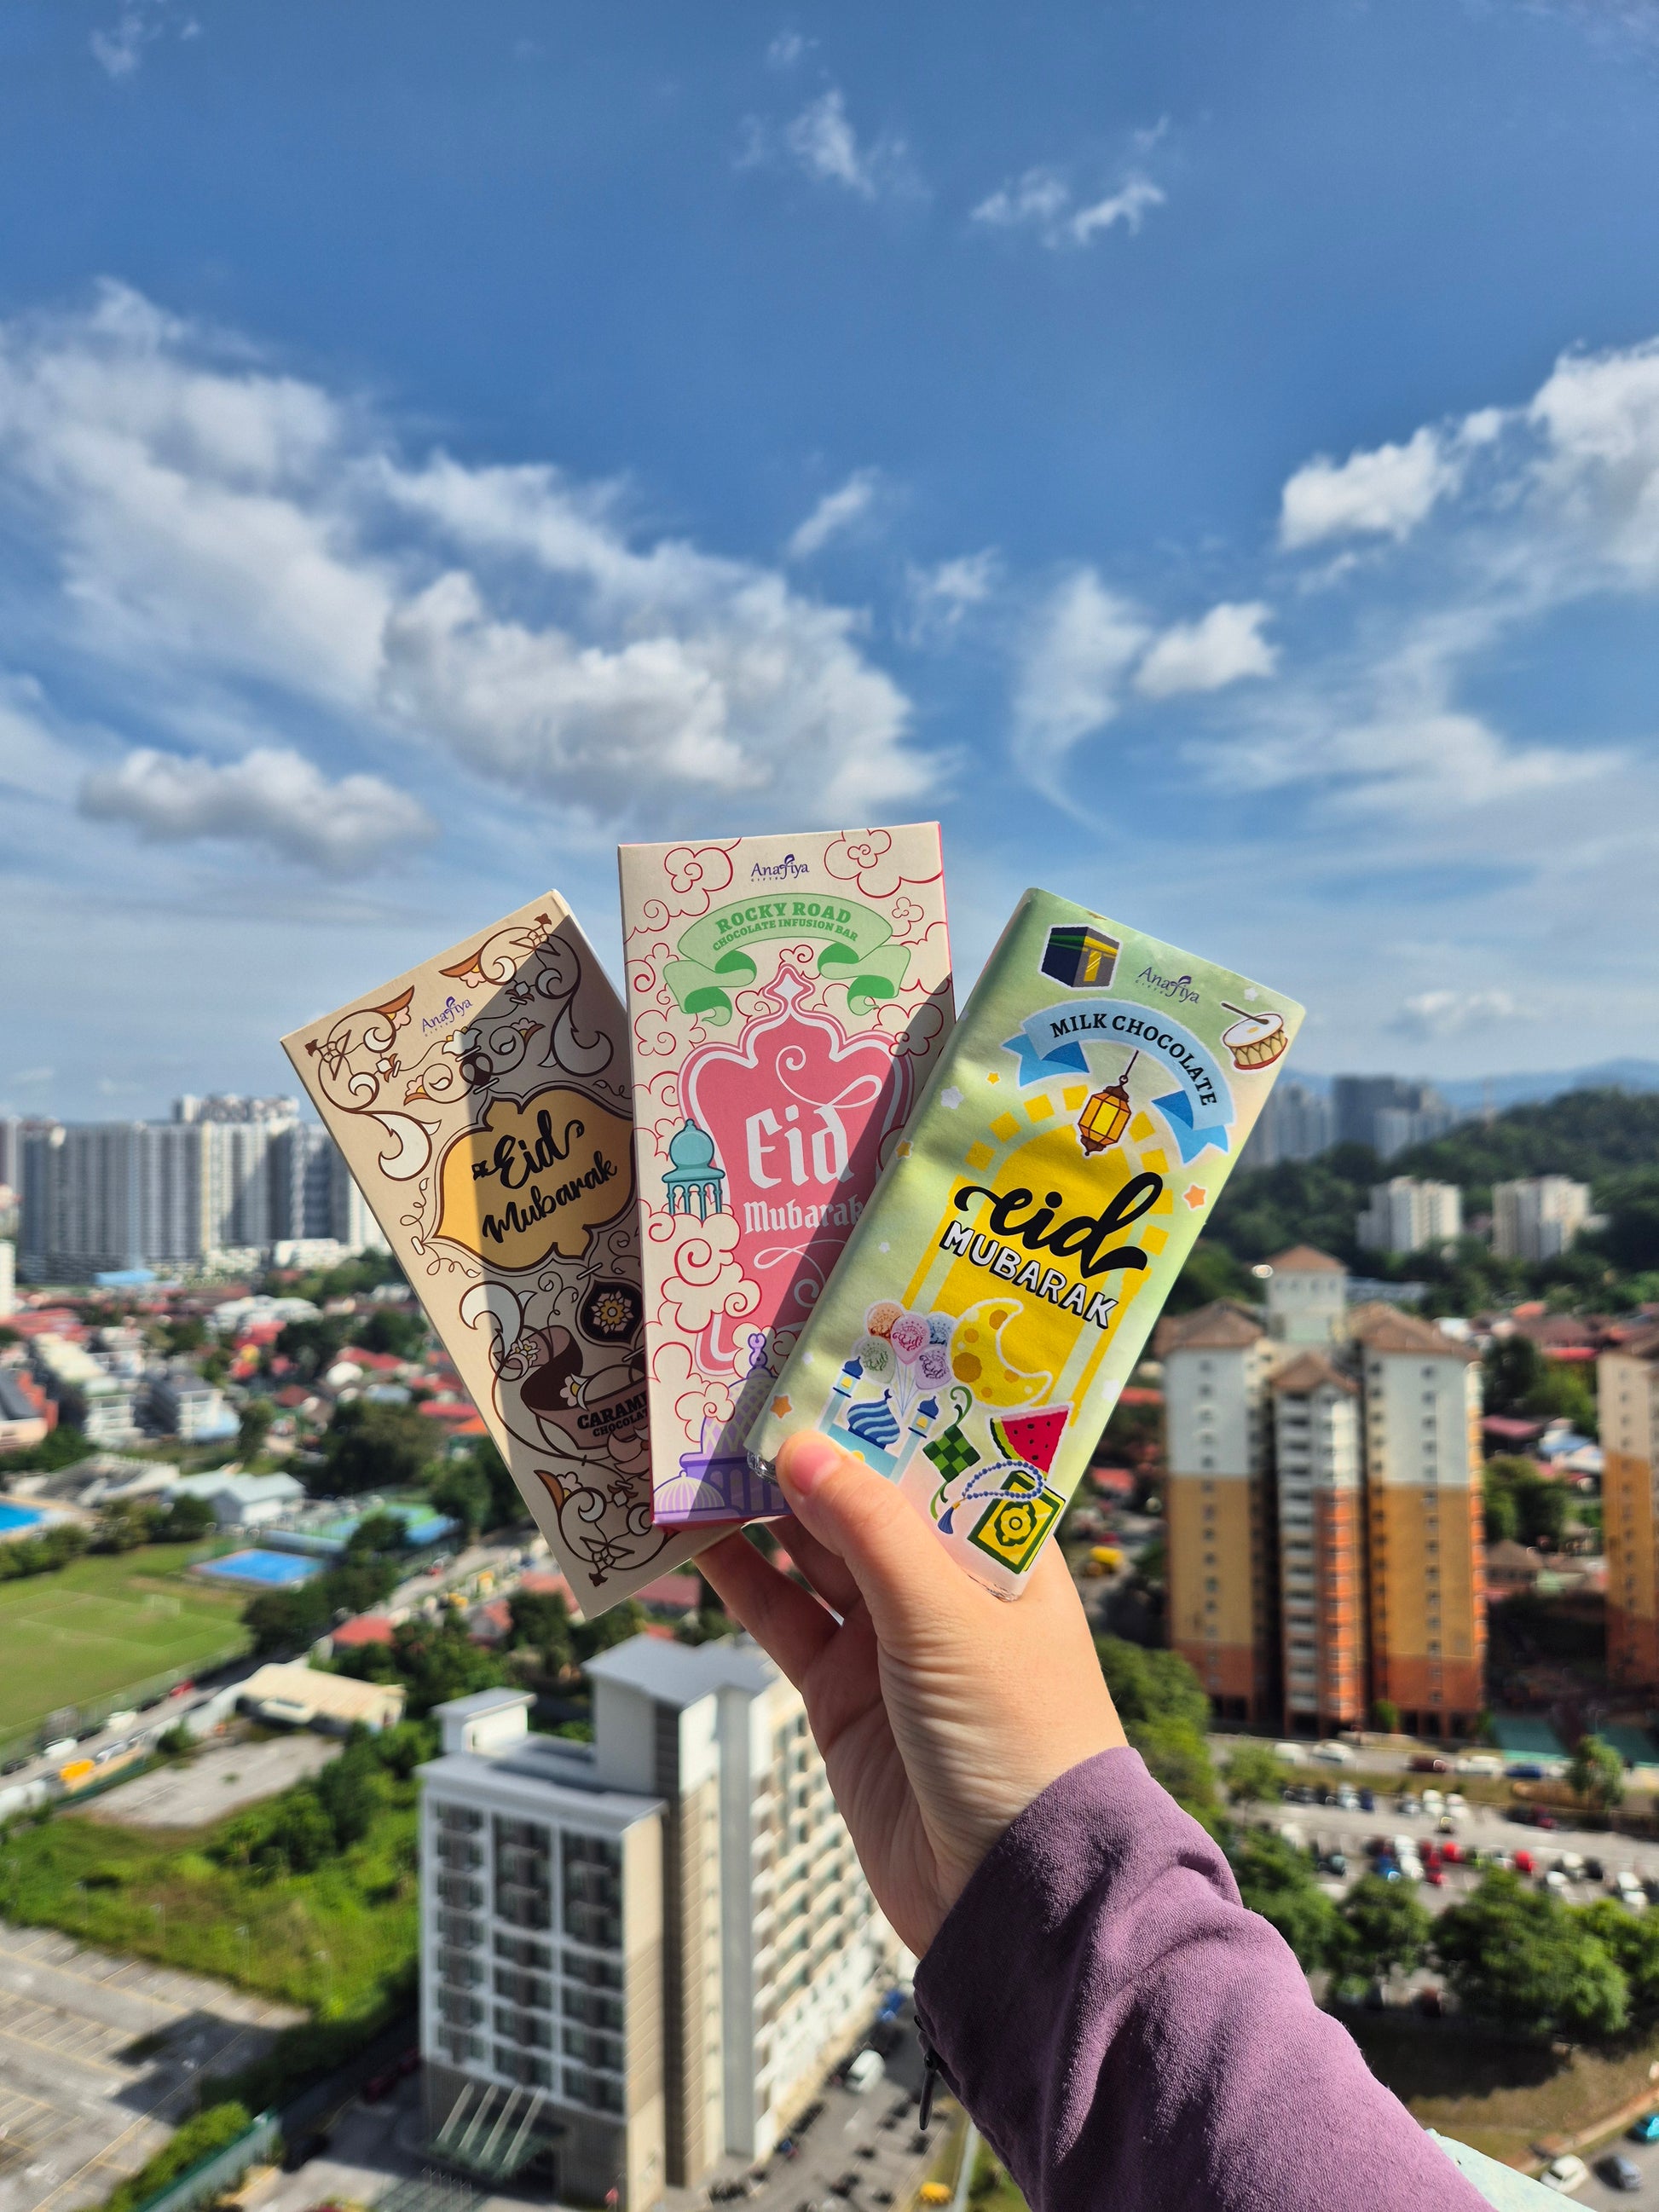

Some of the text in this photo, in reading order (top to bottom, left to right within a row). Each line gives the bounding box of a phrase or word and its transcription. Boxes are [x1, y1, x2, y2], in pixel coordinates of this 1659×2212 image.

[712, 918, 858, 951] CHOCOLATE INFUSION BAR
[714, 902, 852, 934] ROCKY ROAD
[1049, 1013, 1218, 1107] MILK CHOCOLATE
[486, 1109, 585, 1190] Eid
[745, 1104, 854, 1189] Eid
[482, 1151, 618, 1243] Mubarak
[743, 1193, 864, 1235] Mubarak
[953, 1171, 1164, 1279] eid
[939, 1220, 1119, 1330] MUBARAK
